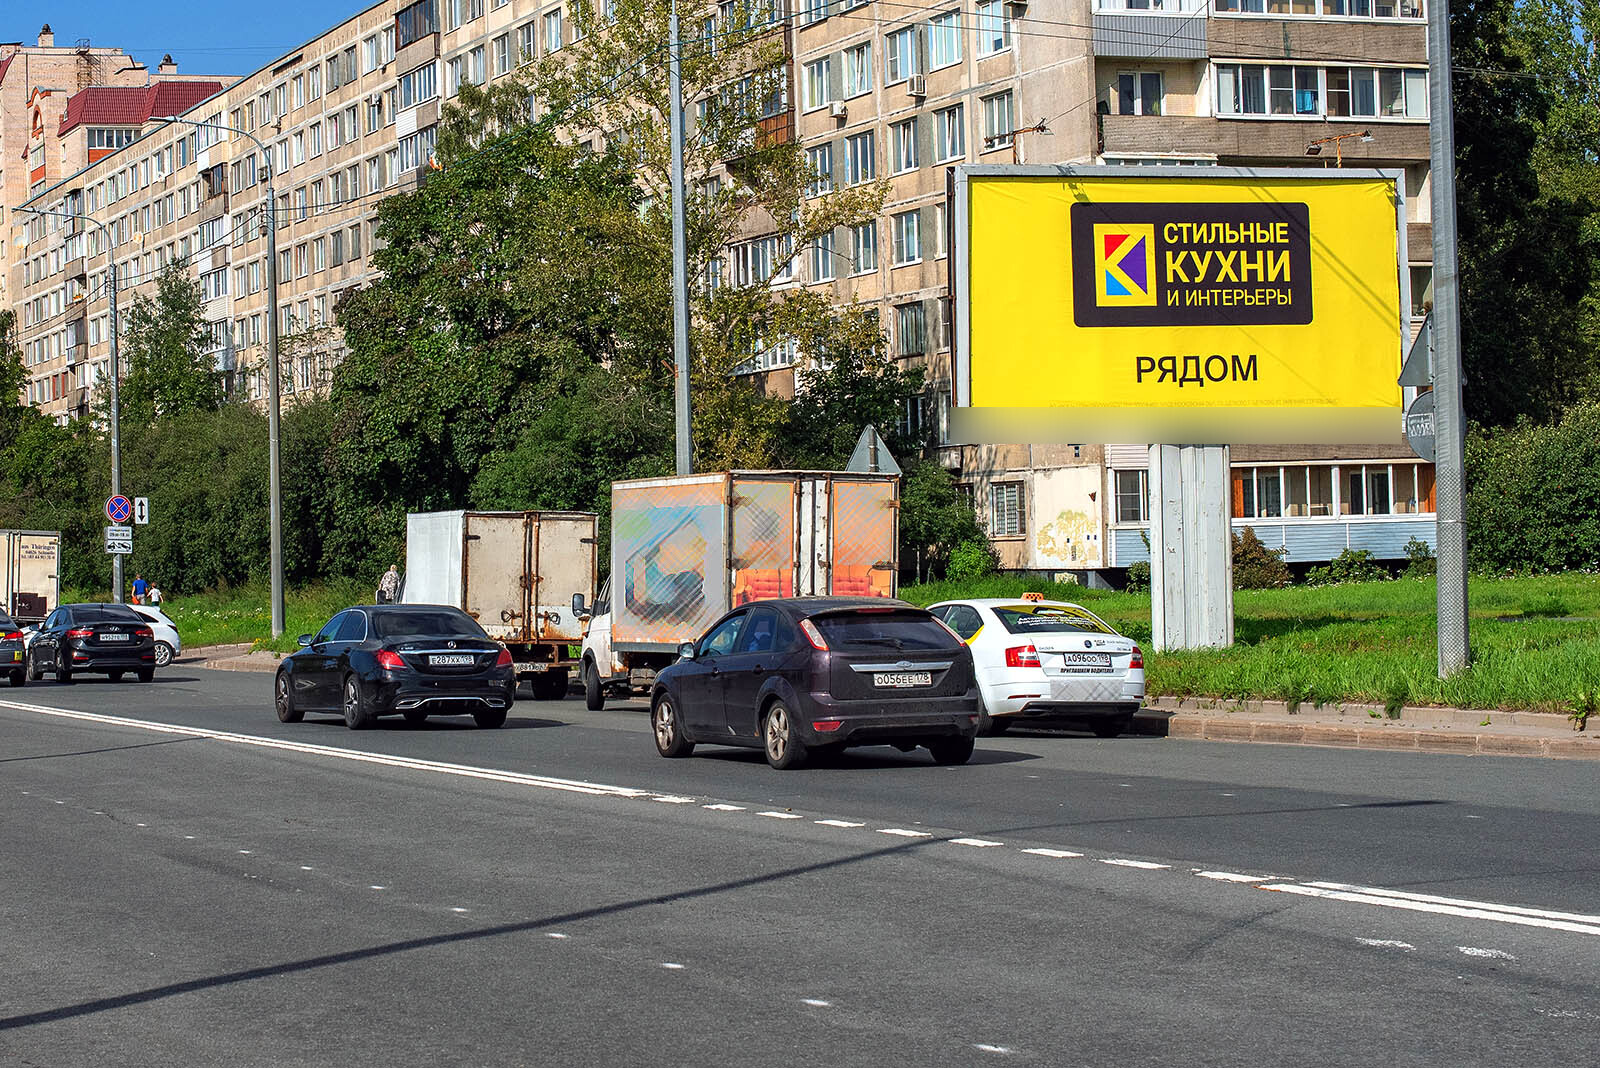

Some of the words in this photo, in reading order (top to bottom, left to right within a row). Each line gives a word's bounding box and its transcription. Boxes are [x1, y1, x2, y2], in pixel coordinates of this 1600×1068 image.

[1163, 222, 1289, 244] СТИЛЬНЫЕ
[1165, 250, 1291, 283] КУХНИ
[1167, 289, 1179, 306] И
[1185, 288, 1292, 306] ИНТЕРЬЕРЫ
[1136, 354, 1258, 388] РЯДОМ
